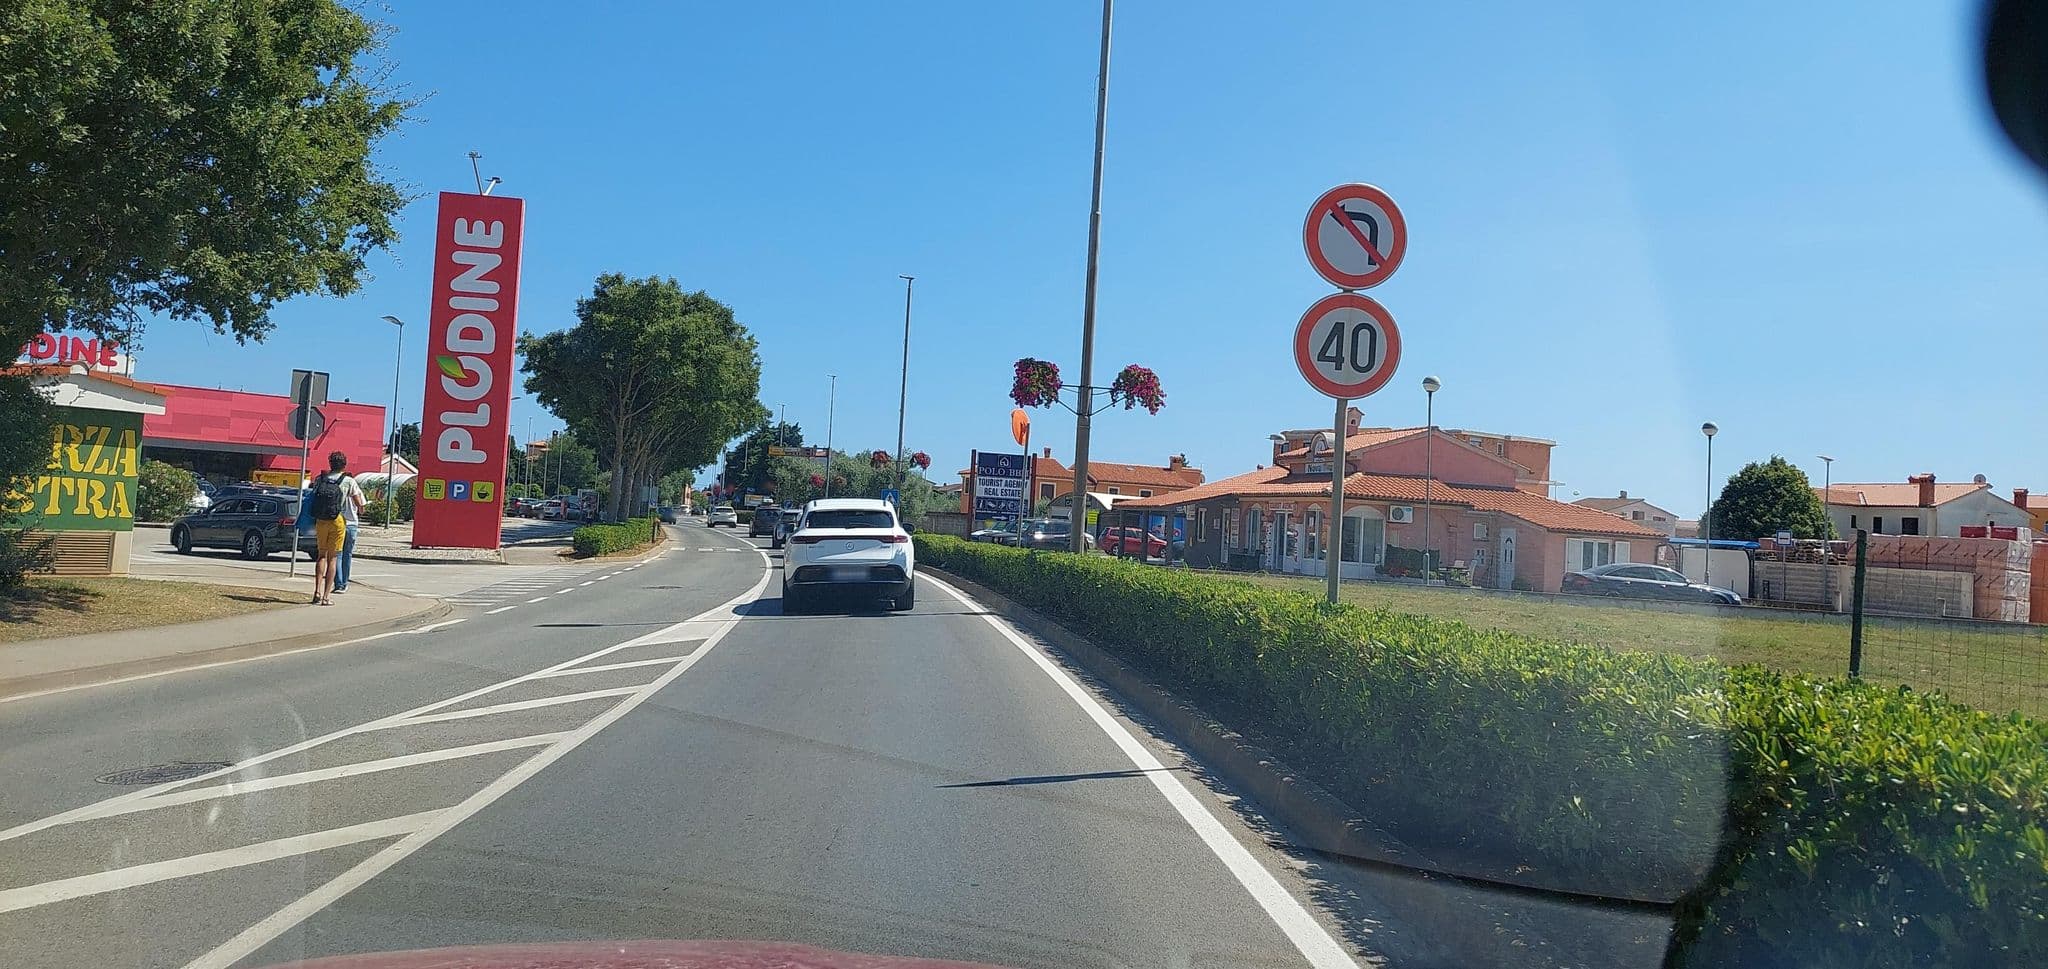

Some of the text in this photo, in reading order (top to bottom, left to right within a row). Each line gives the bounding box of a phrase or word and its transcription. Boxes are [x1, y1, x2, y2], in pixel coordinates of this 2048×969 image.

[18, 332, 120, 367] DINE
[436, 216, 505, 464] PLODINE
[1317, 322, 1377, 373] 40
[979, 467, 1005, 475] POLO
[979, 478, 1028, 488] TOURIST AGENY
[984, 488, 1021, 497] REAL ESTATE
